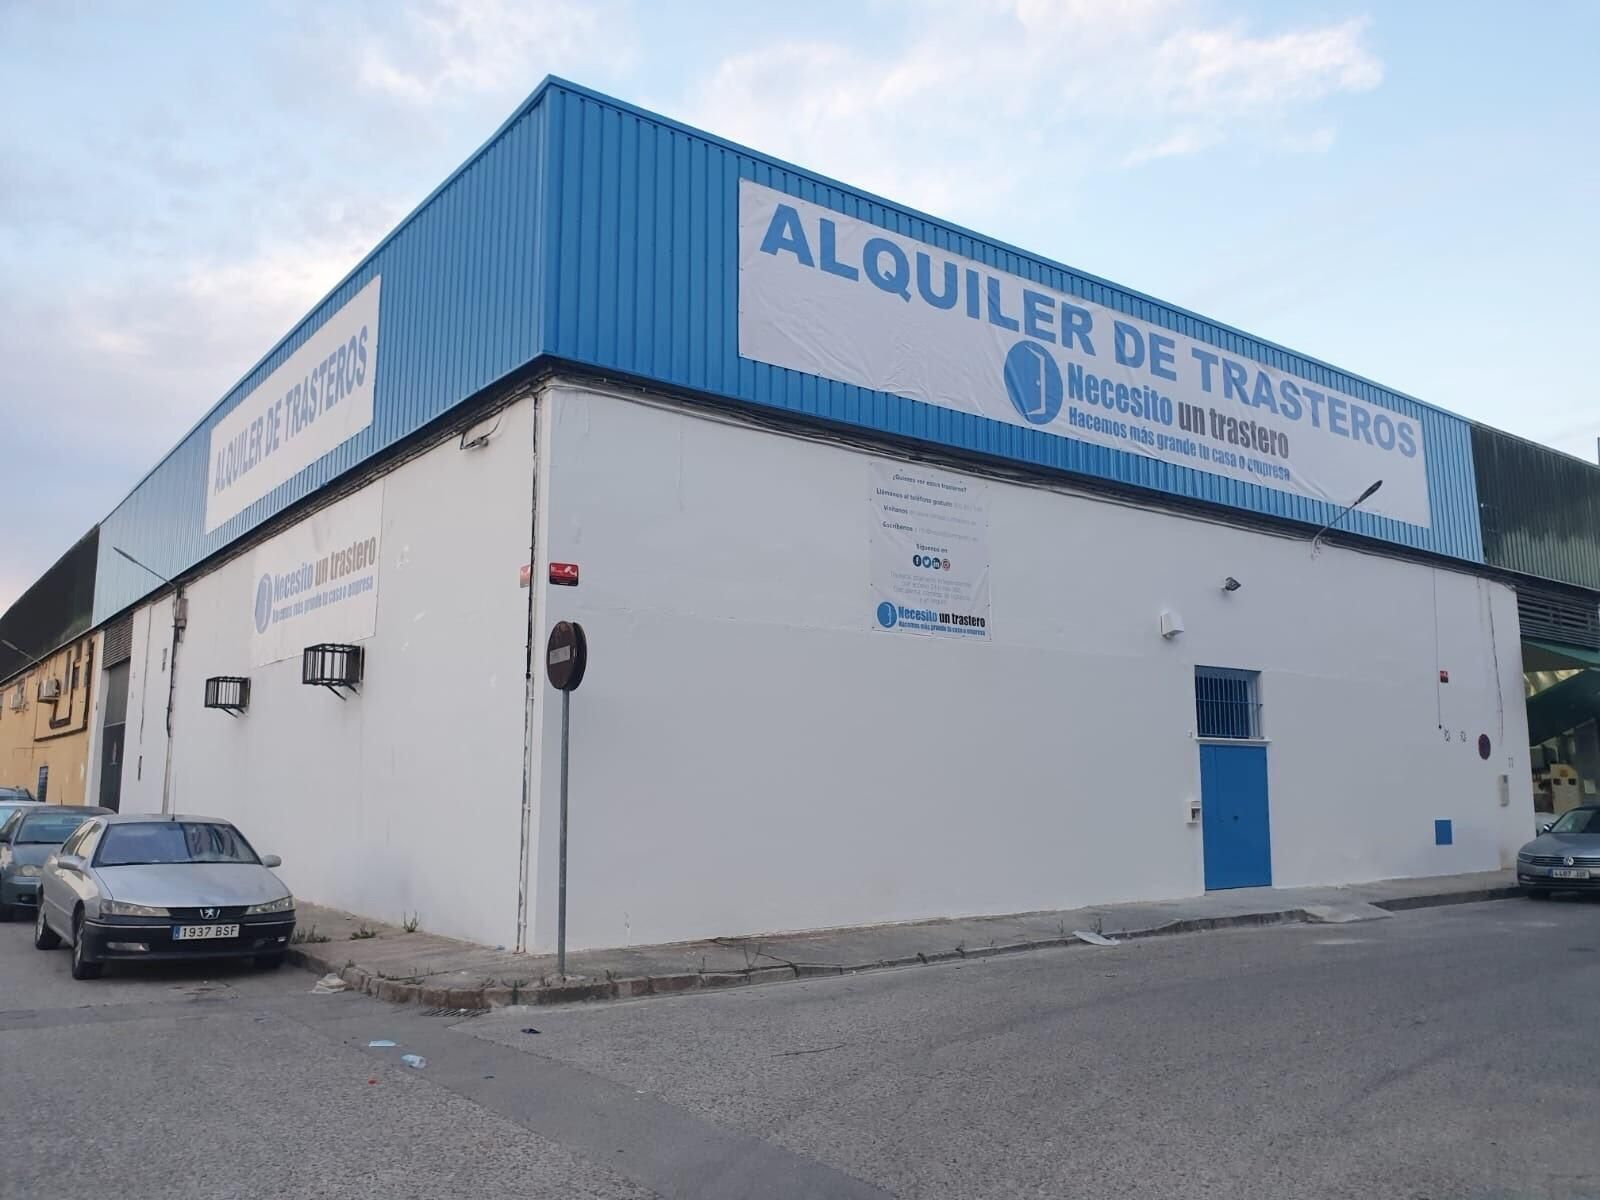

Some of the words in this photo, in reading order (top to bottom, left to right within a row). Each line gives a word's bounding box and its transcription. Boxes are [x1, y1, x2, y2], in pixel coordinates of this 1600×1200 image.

[760, 203, 1096, 357] ALQUILER
[1114, 320, 1177, 382] DE
[1192, 346, 1417, 458] TRASTEROS
[214, 415, 265, 496] ALQUILER
[265, 398, 283, 458] DE
[285, 325, 368, 443] TRASTEROS
[1067, 362, 1174, 427] Necesito
[1178, 400, 1206, 436] un
[1209, 407, 1289, 460] trastero
[1068, 405, 1128, 439] Hacemos
[1129, 425, 1155, 446] más
[1156, 434, 1197, 458] grande
[1198, 442, 1211, 460] tu
[1211, 448, 1237, 467] casa
[1238, 456, 1246, 470] o
[1247, 458, 1291, 481] empresa
[876, 487, 903, 499] Llámanos
[273, 562, 314, 603] Necesito
[314, 556, 329, 587] un
[330, 536, 376, 581] trastero
[898, 606, 938, 623] Necesito
[939, 612, 951, 624] un
[951, 612, 986, 628] trastero
[183, 926, 212, 937] 1937
[215, 925, 238, 936] BSF
